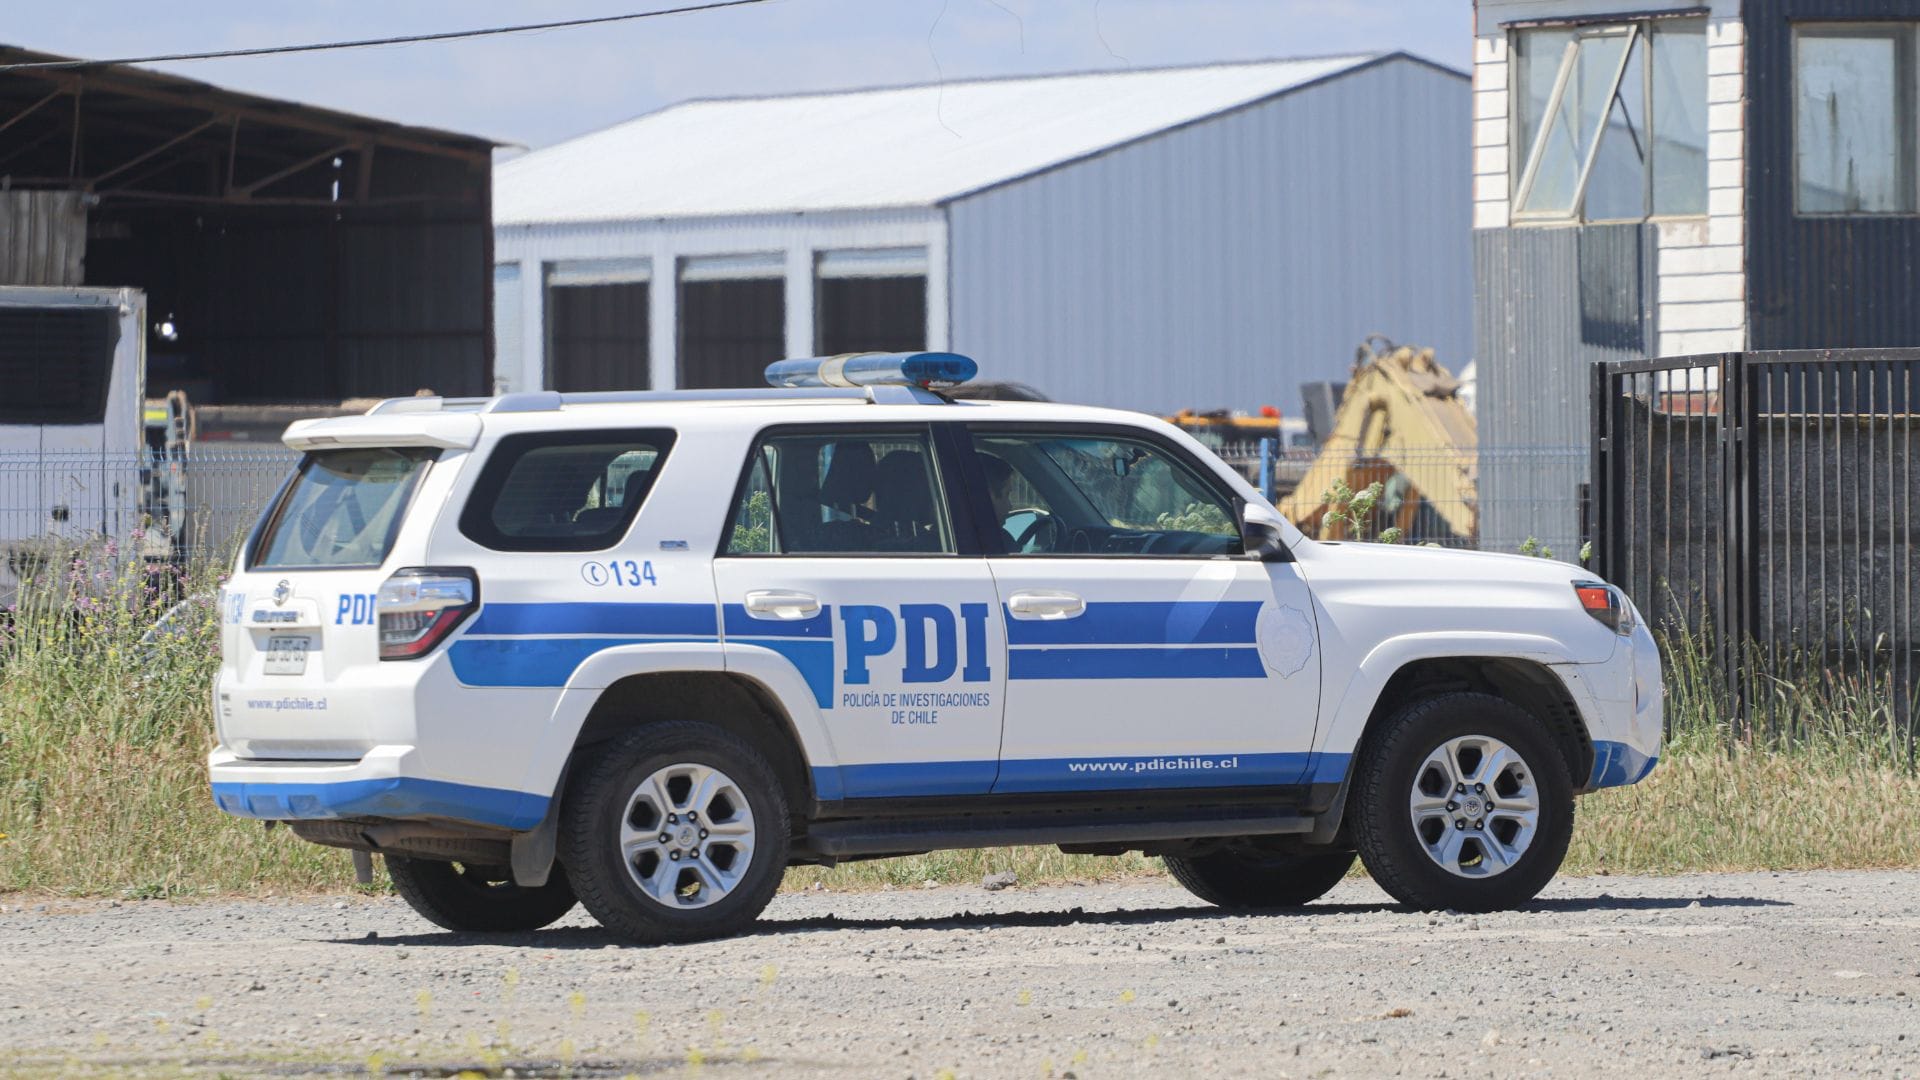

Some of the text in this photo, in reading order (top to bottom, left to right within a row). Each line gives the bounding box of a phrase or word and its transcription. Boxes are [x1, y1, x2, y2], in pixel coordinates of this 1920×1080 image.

[610, 560, 657, 587] 134
[335, 593, 377, 625] PDI
[839, 603, 991, 685] PDI
[248, 697, 327, 712] www.pdichile.cl
[883, 693, 896, 707] DE
[899, 692, 990, 707] INVESTIGACIONES
[892, 710, 938, 724] DE CHILE
[1068, 756, 1239, 773] www.pdichile.cl
